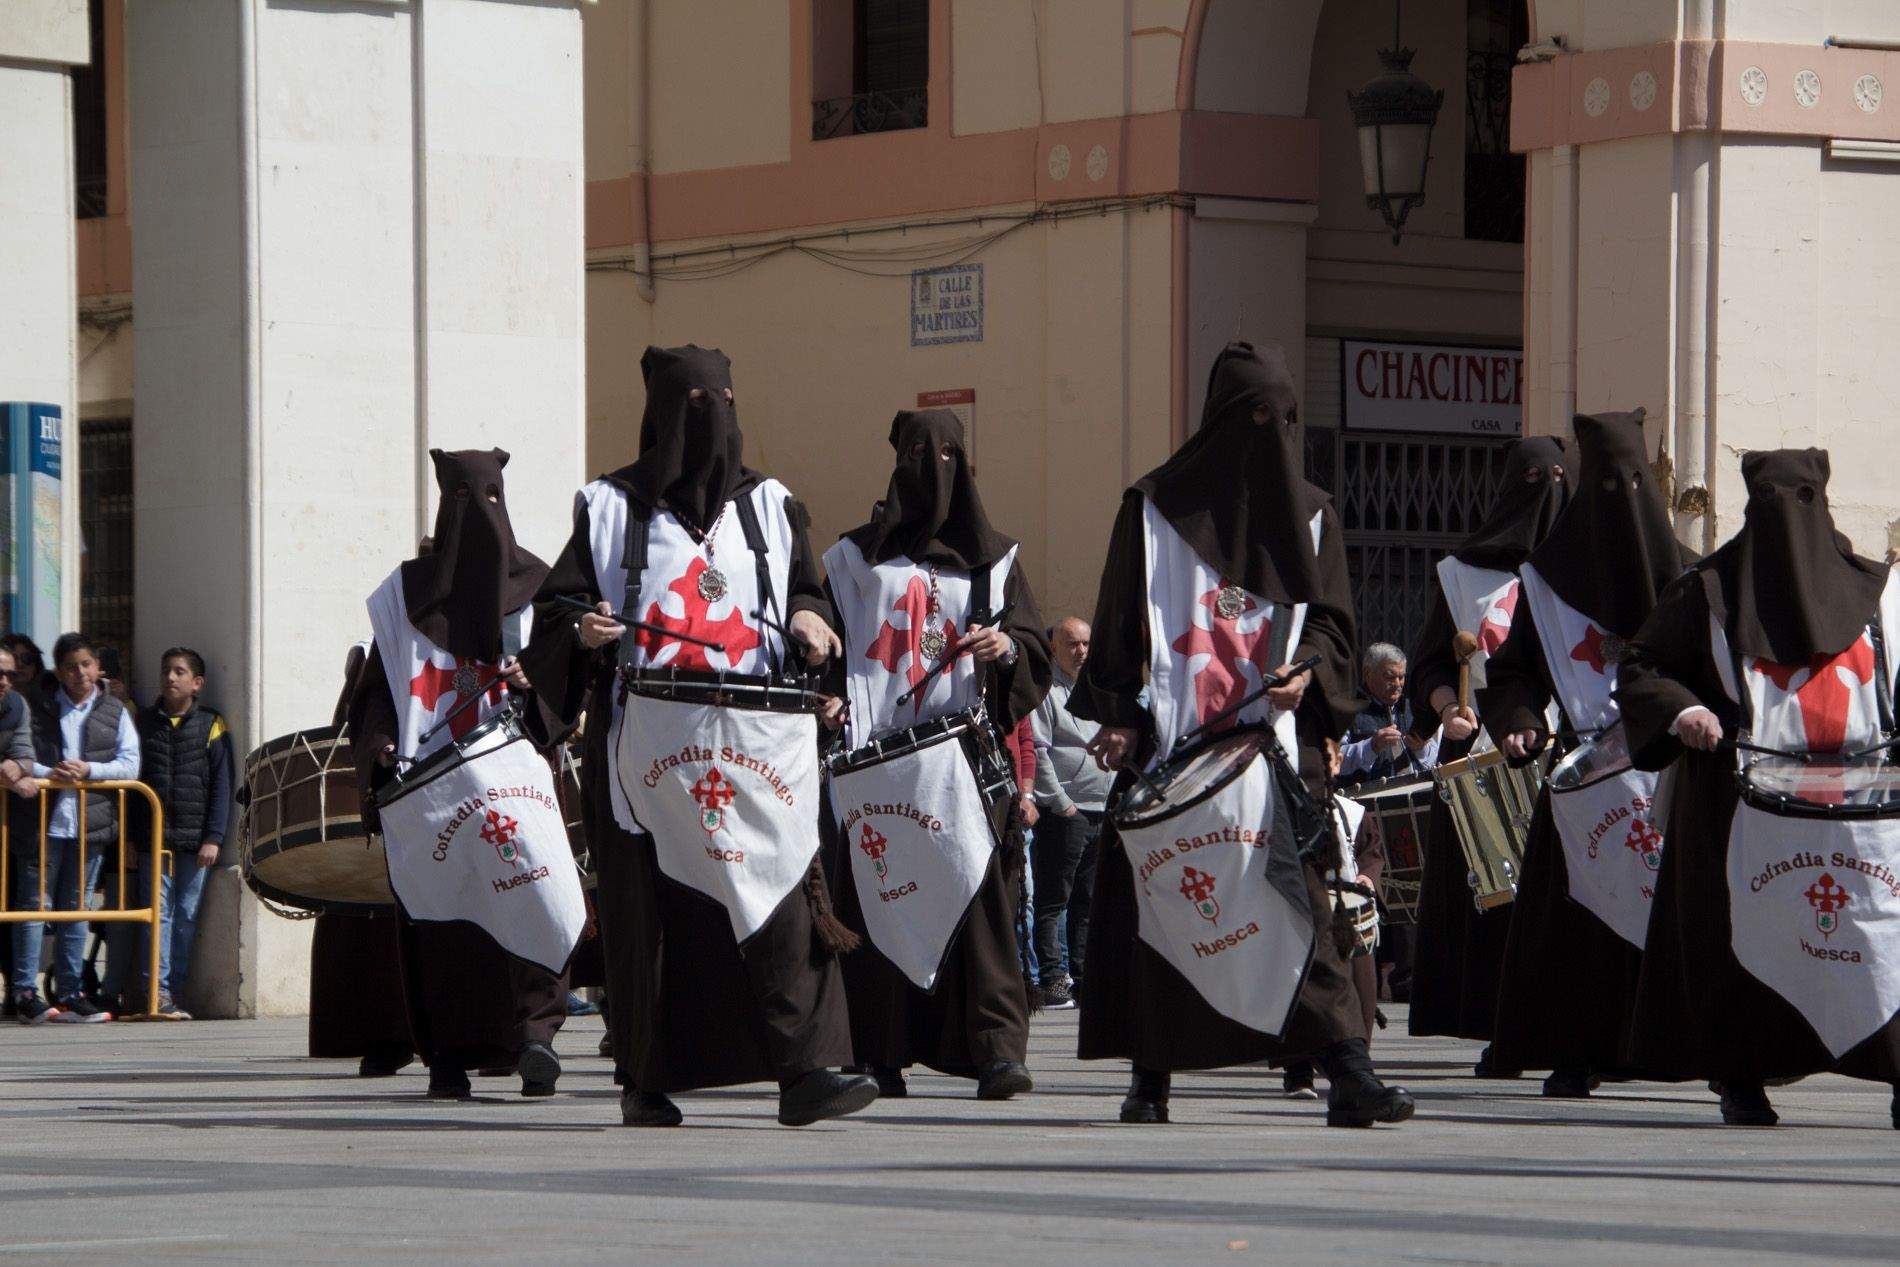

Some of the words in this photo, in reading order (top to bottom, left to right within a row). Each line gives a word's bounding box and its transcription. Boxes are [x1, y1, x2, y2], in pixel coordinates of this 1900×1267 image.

[938, 275, 972, 293] CALLE
[939, 298, 951, 311] DE
[954, 295, 972, 309] LAS
[39, 415, 61, 440] HU
[1472, 419, 1501, 431] CASA
[643, 745, 714, 788] Cofradia
[720, 746, 794, 806] Santiago
[432, 797, 485, 862] Cofradia
[863, 802, 942, 831] Santiago
[705, 845, 744, 863] esca
[491, 865, 550, 893] Huesca
[1750, 851, 1826, 892] Cofradia
[1830, 852, 1900, 897] Santiag
[879, 881, 918, 902] esca
[1191, 921, 1260, 958] Huesca
[1800, 937, 1862, 963] Huesca
